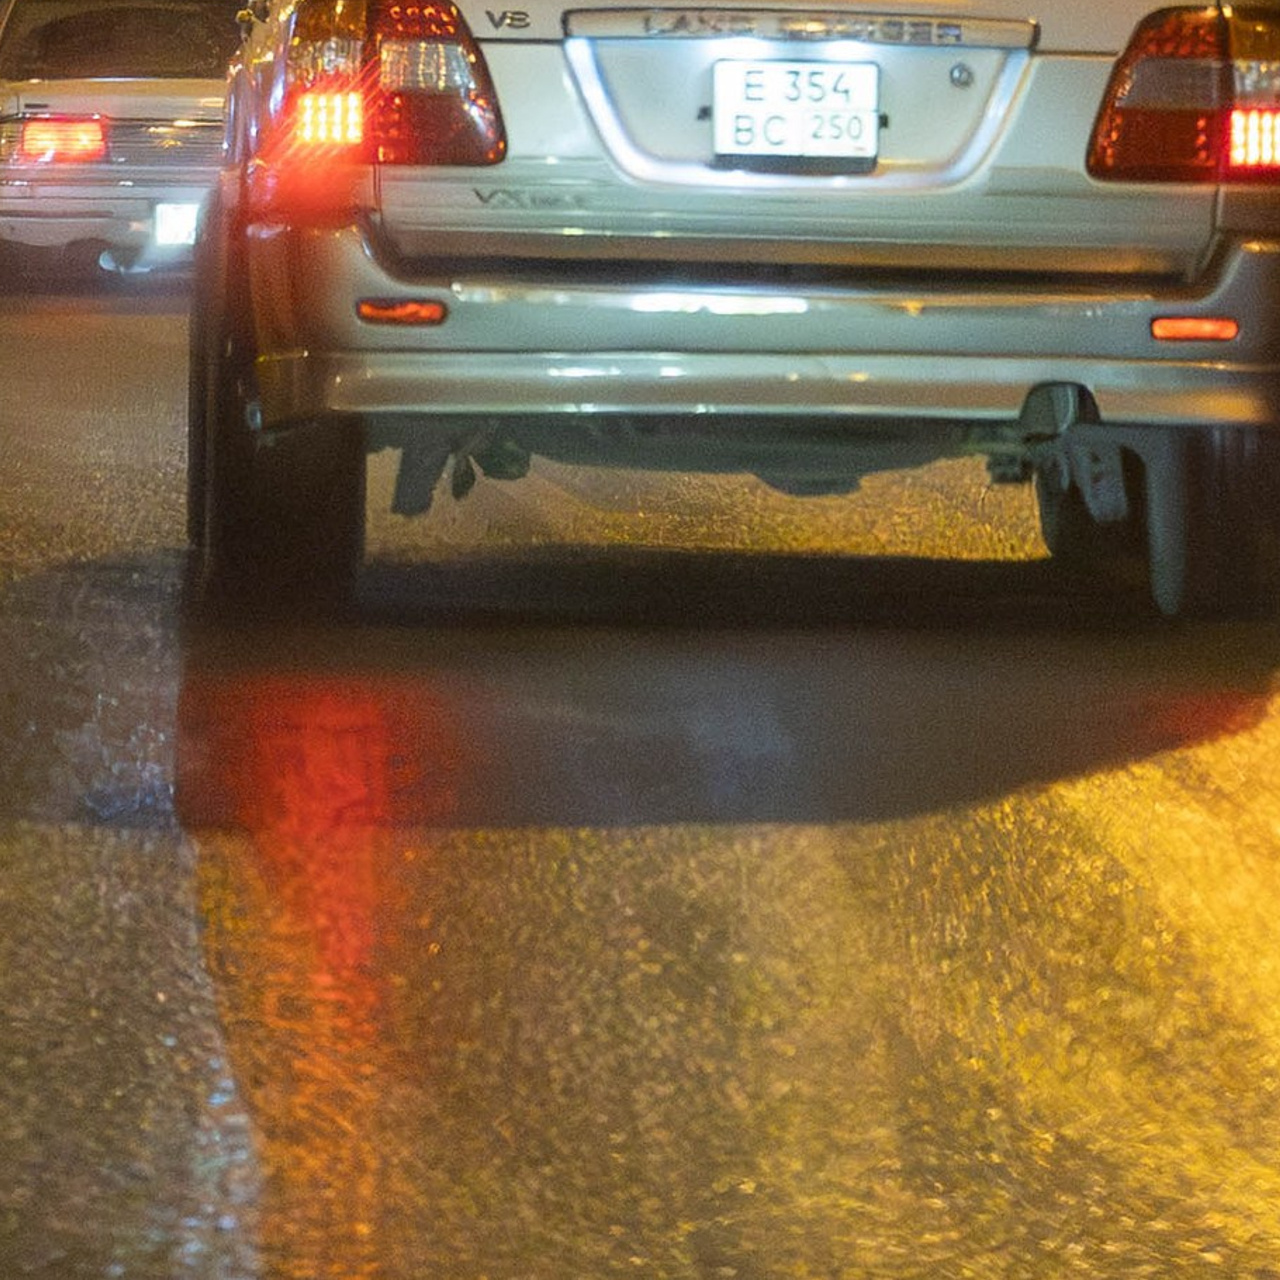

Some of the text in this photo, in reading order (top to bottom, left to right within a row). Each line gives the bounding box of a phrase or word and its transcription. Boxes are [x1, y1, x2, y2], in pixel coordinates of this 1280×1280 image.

[485, 10, 531, 30] V8
[784, 70, 851, 102] 354
[811, 114, 863, 141] 250
